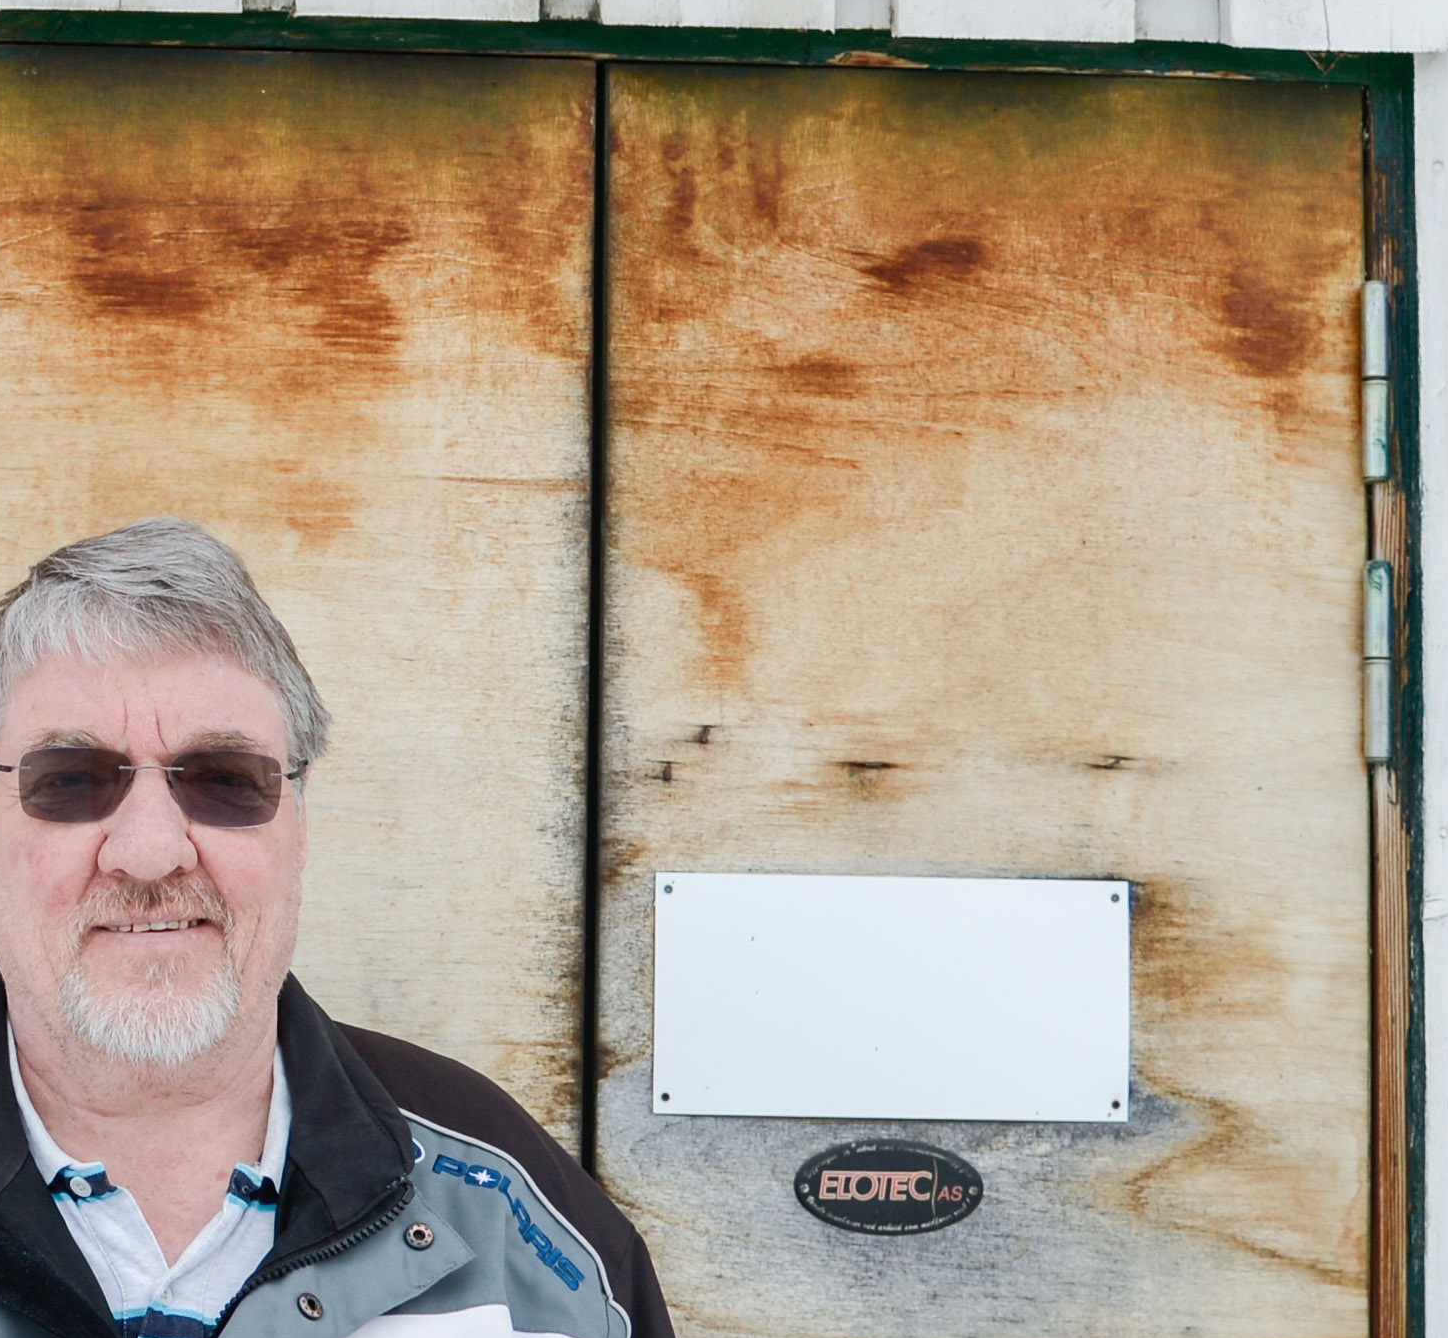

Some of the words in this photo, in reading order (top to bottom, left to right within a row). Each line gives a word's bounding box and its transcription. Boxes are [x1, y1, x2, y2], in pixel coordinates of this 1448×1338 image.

[432, 1154, 585, 1291] POLARIS
[818, 1170, 933, 1202] ELOTEC
[937, 1185, 964, 1202] AS
